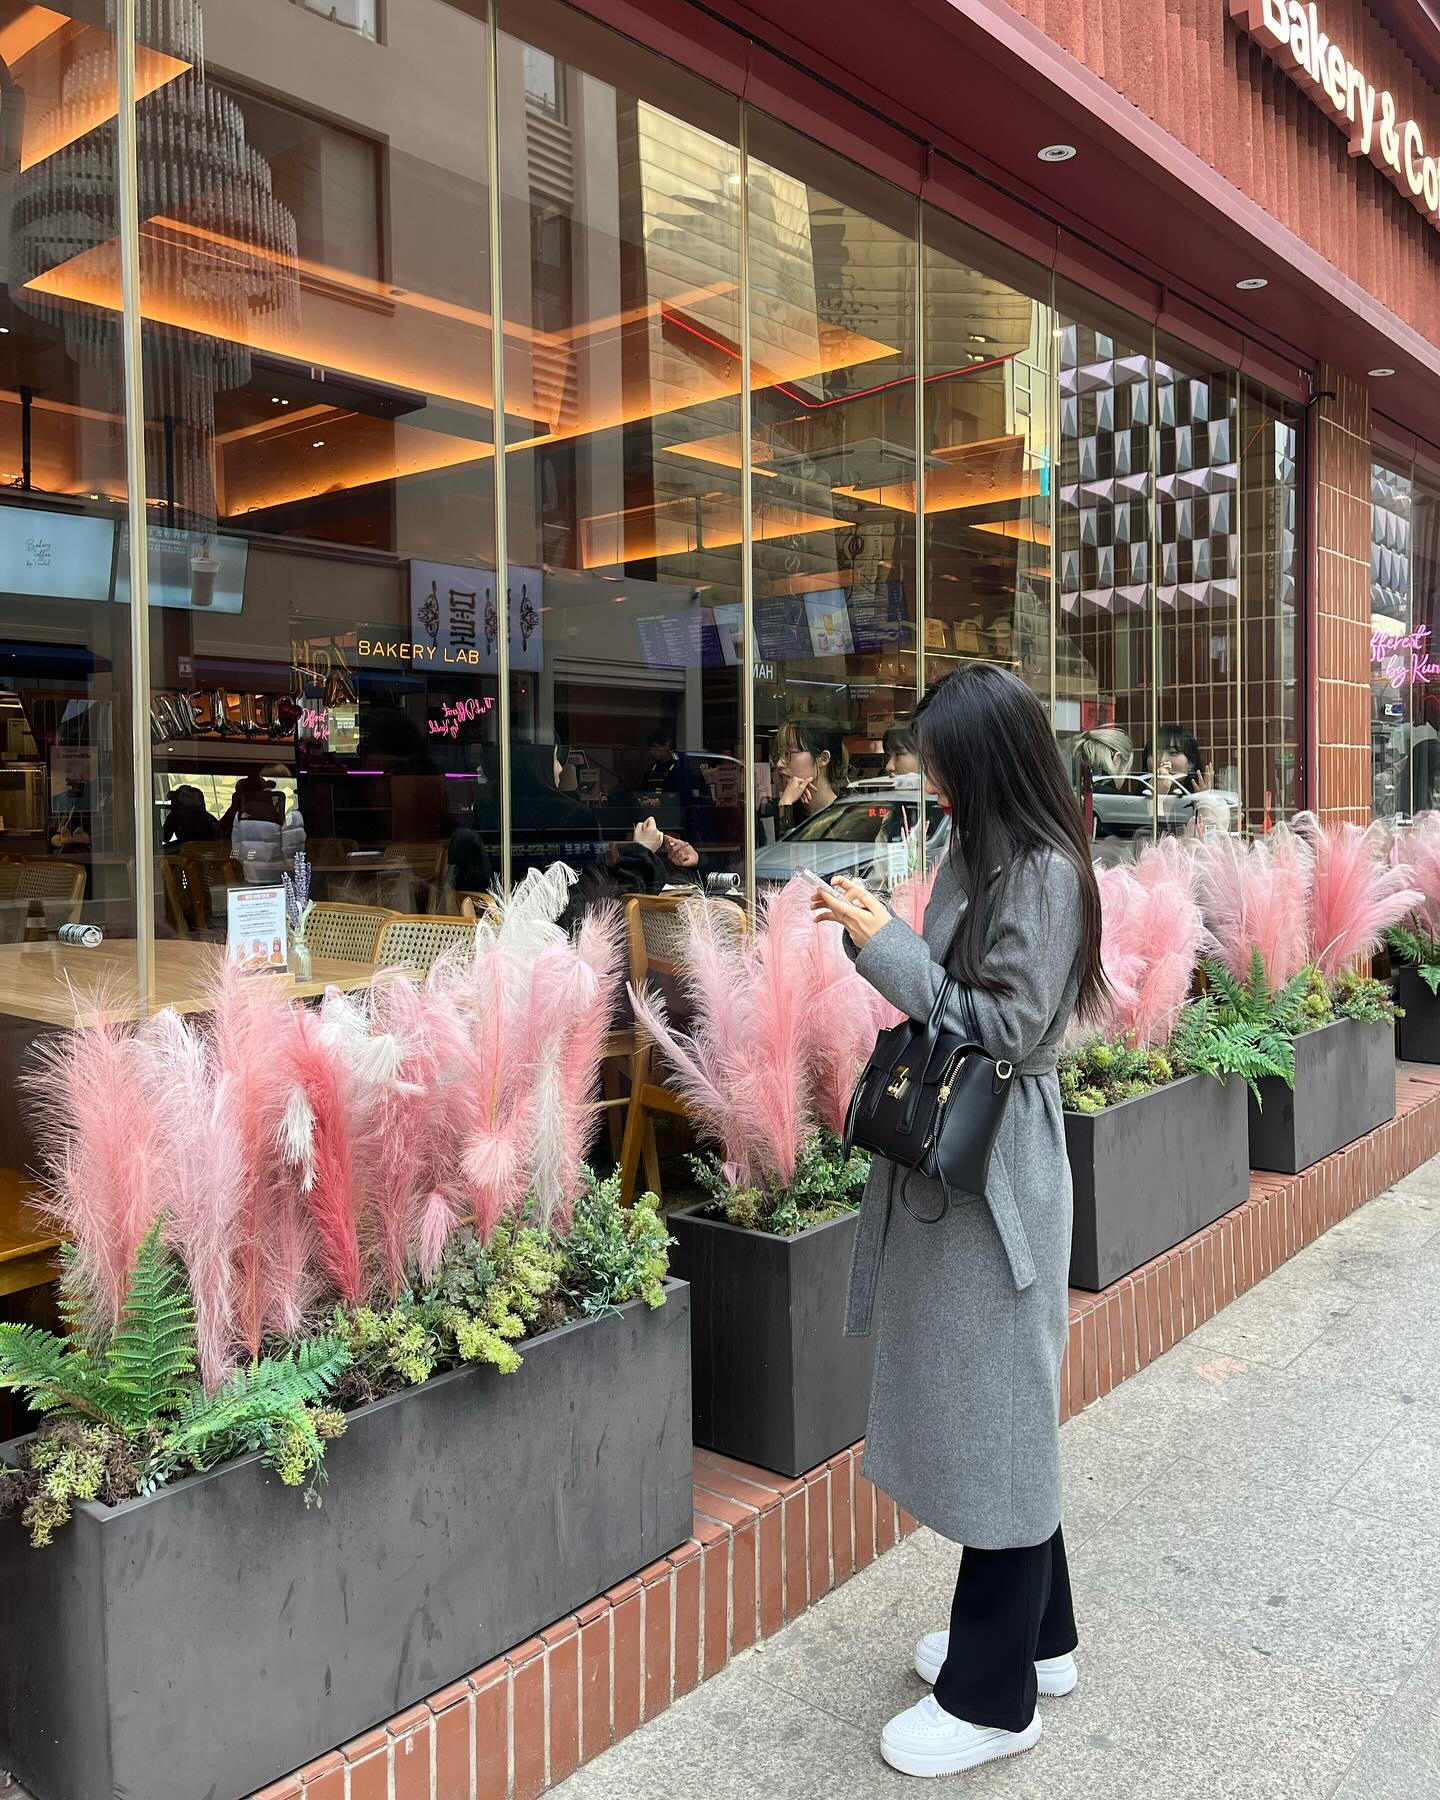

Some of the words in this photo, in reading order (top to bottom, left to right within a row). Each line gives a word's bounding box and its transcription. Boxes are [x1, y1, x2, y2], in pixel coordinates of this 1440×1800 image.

[1405, 120, 1440, 220] Co
[358, 640, 437, 660] BAKERY
[444, 648, 480, 664] LAB
